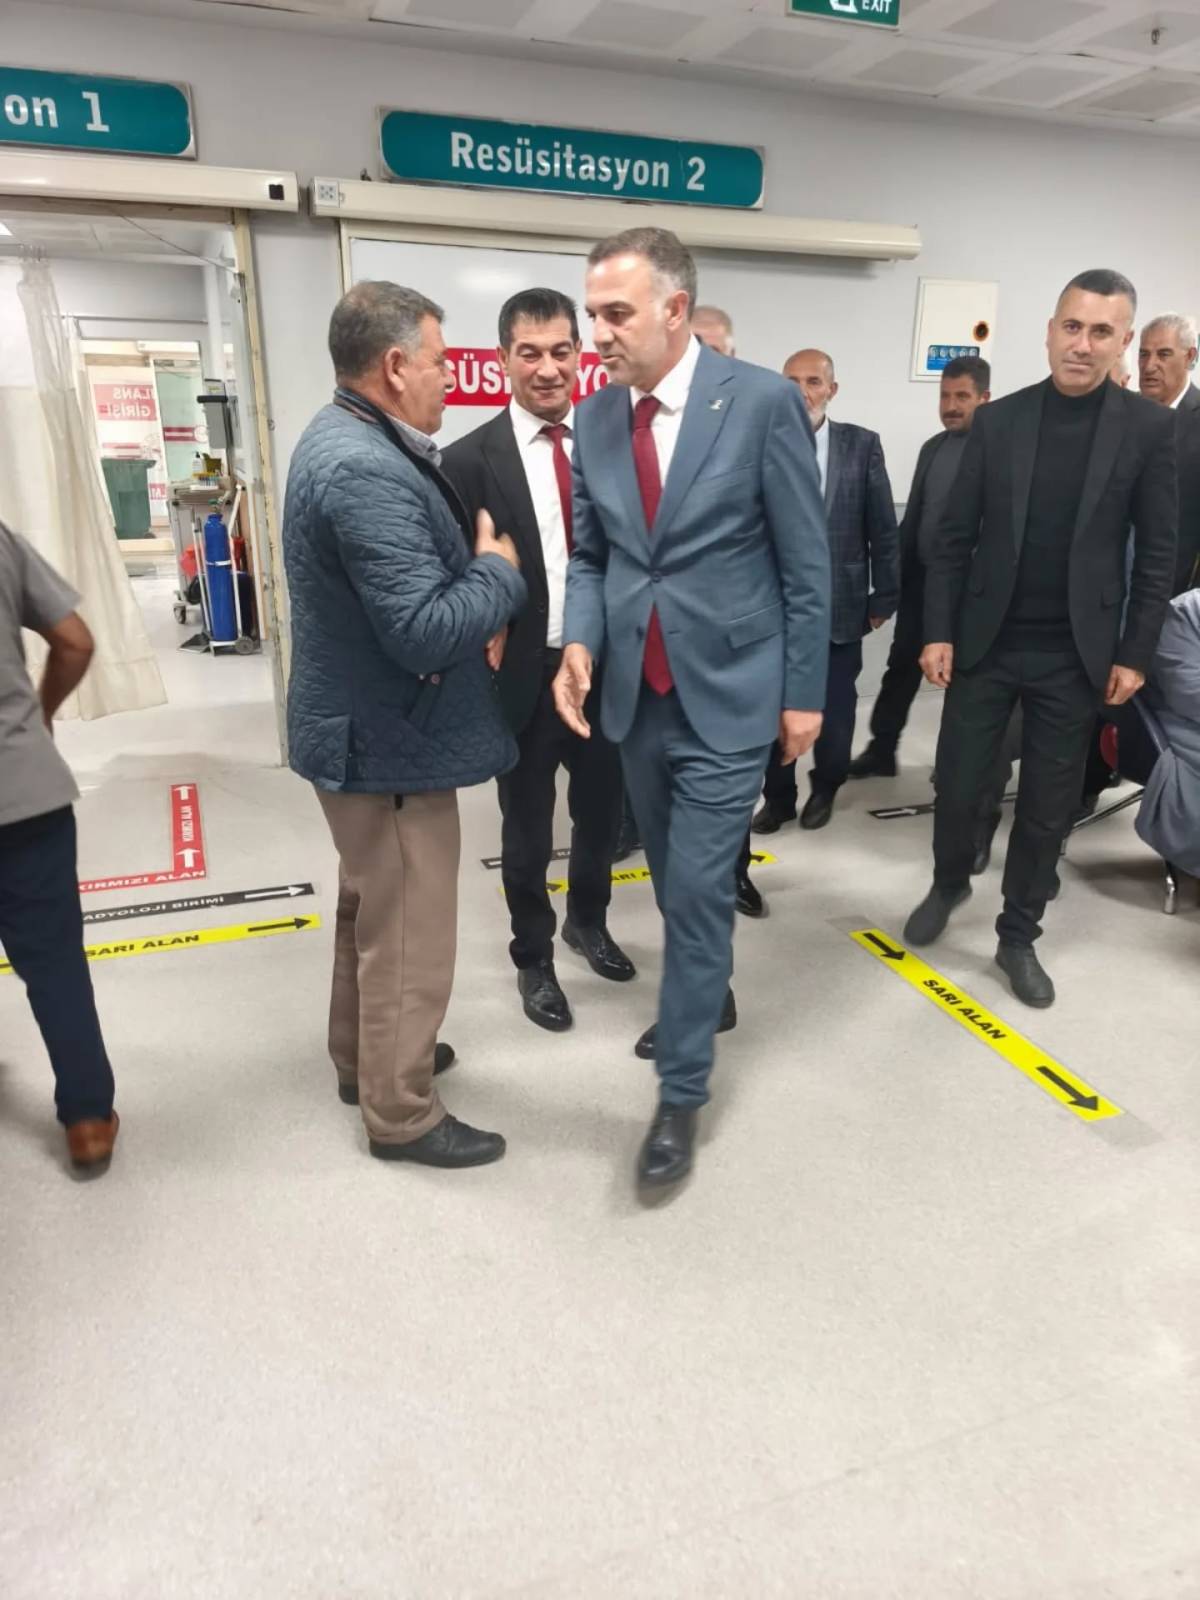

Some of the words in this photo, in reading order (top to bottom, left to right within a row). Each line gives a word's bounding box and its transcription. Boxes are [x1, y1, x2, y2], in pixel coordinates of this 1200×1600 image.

[862, 0, 892, 13] EXIT
[82, 91, 109, 132] 1
[451, 131, 670, 191] Resüsitasyon
[686, 156, 706, 191] 2
[80, 876, 148, 891] KIRMIZI
[155, 870, 205, 882] ALAN
[83, 904, 166, 921] ADYOLOJİ
[85, 943, 135, 957] SARI
[142, 934, 199, 948] ALAN
[922, 979, 963, 1006] SARI
[957, 1007, 1007, 1040] ALAN
